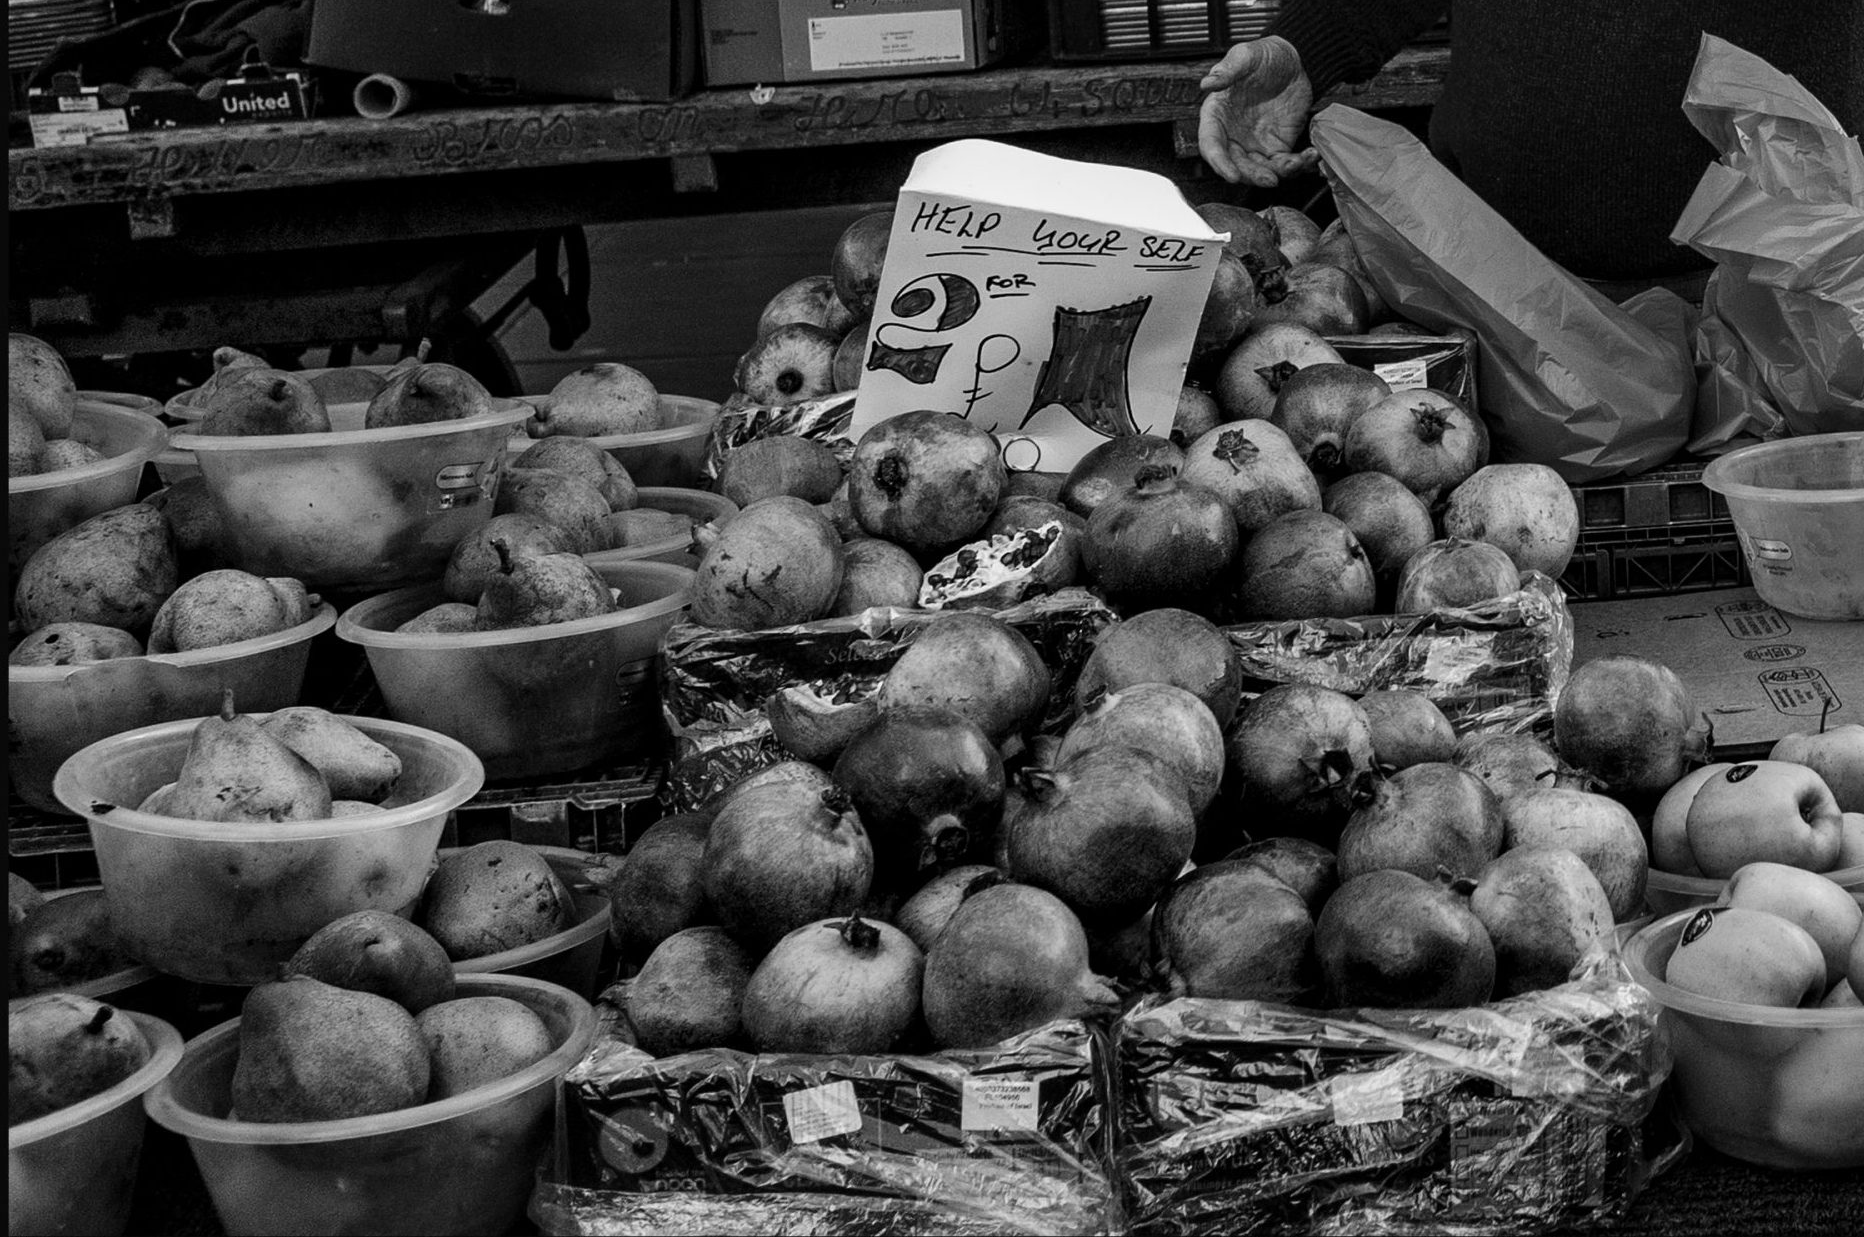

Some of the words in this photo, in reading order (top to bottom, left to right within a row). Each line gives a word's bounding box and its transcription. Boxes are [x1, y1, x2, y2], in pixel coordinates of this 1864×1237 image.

[222, 91, 291, 114] United
[911, 201, 1002, 240] HELP
[1032, 219, 1127, 255] YOUR
[865, 272, 981, 385] 2
[985, 273, 1036, 290] FOR
